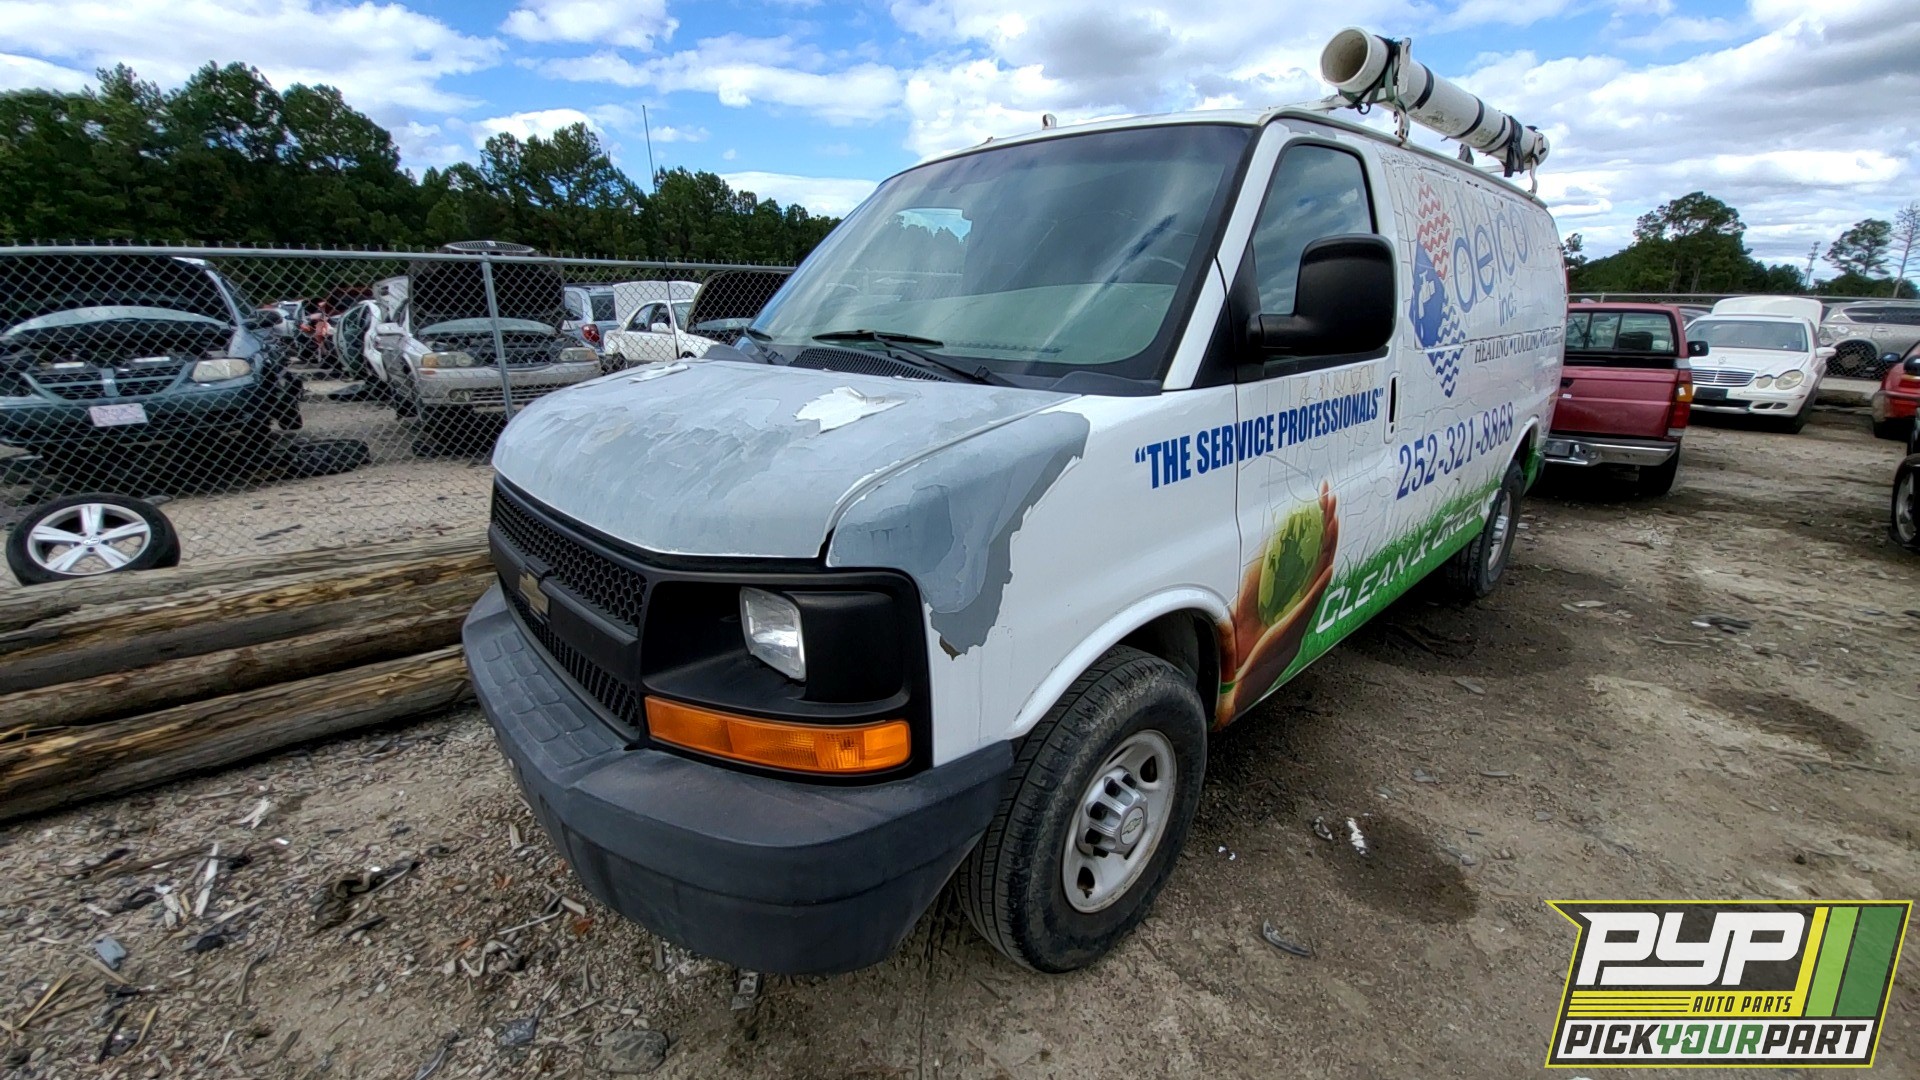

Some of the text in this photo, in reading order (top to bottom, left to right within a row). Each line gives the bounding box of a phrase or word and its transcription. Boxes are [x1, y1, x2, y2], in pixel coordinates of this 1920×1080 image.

[1453, 190, 1528, 313] delco
[1196, 414, 1274, 475] SERVICE
[1396, 401, 1514, 501] 252-321-8868
[1315, 546, 1413, 634] CLEAN
